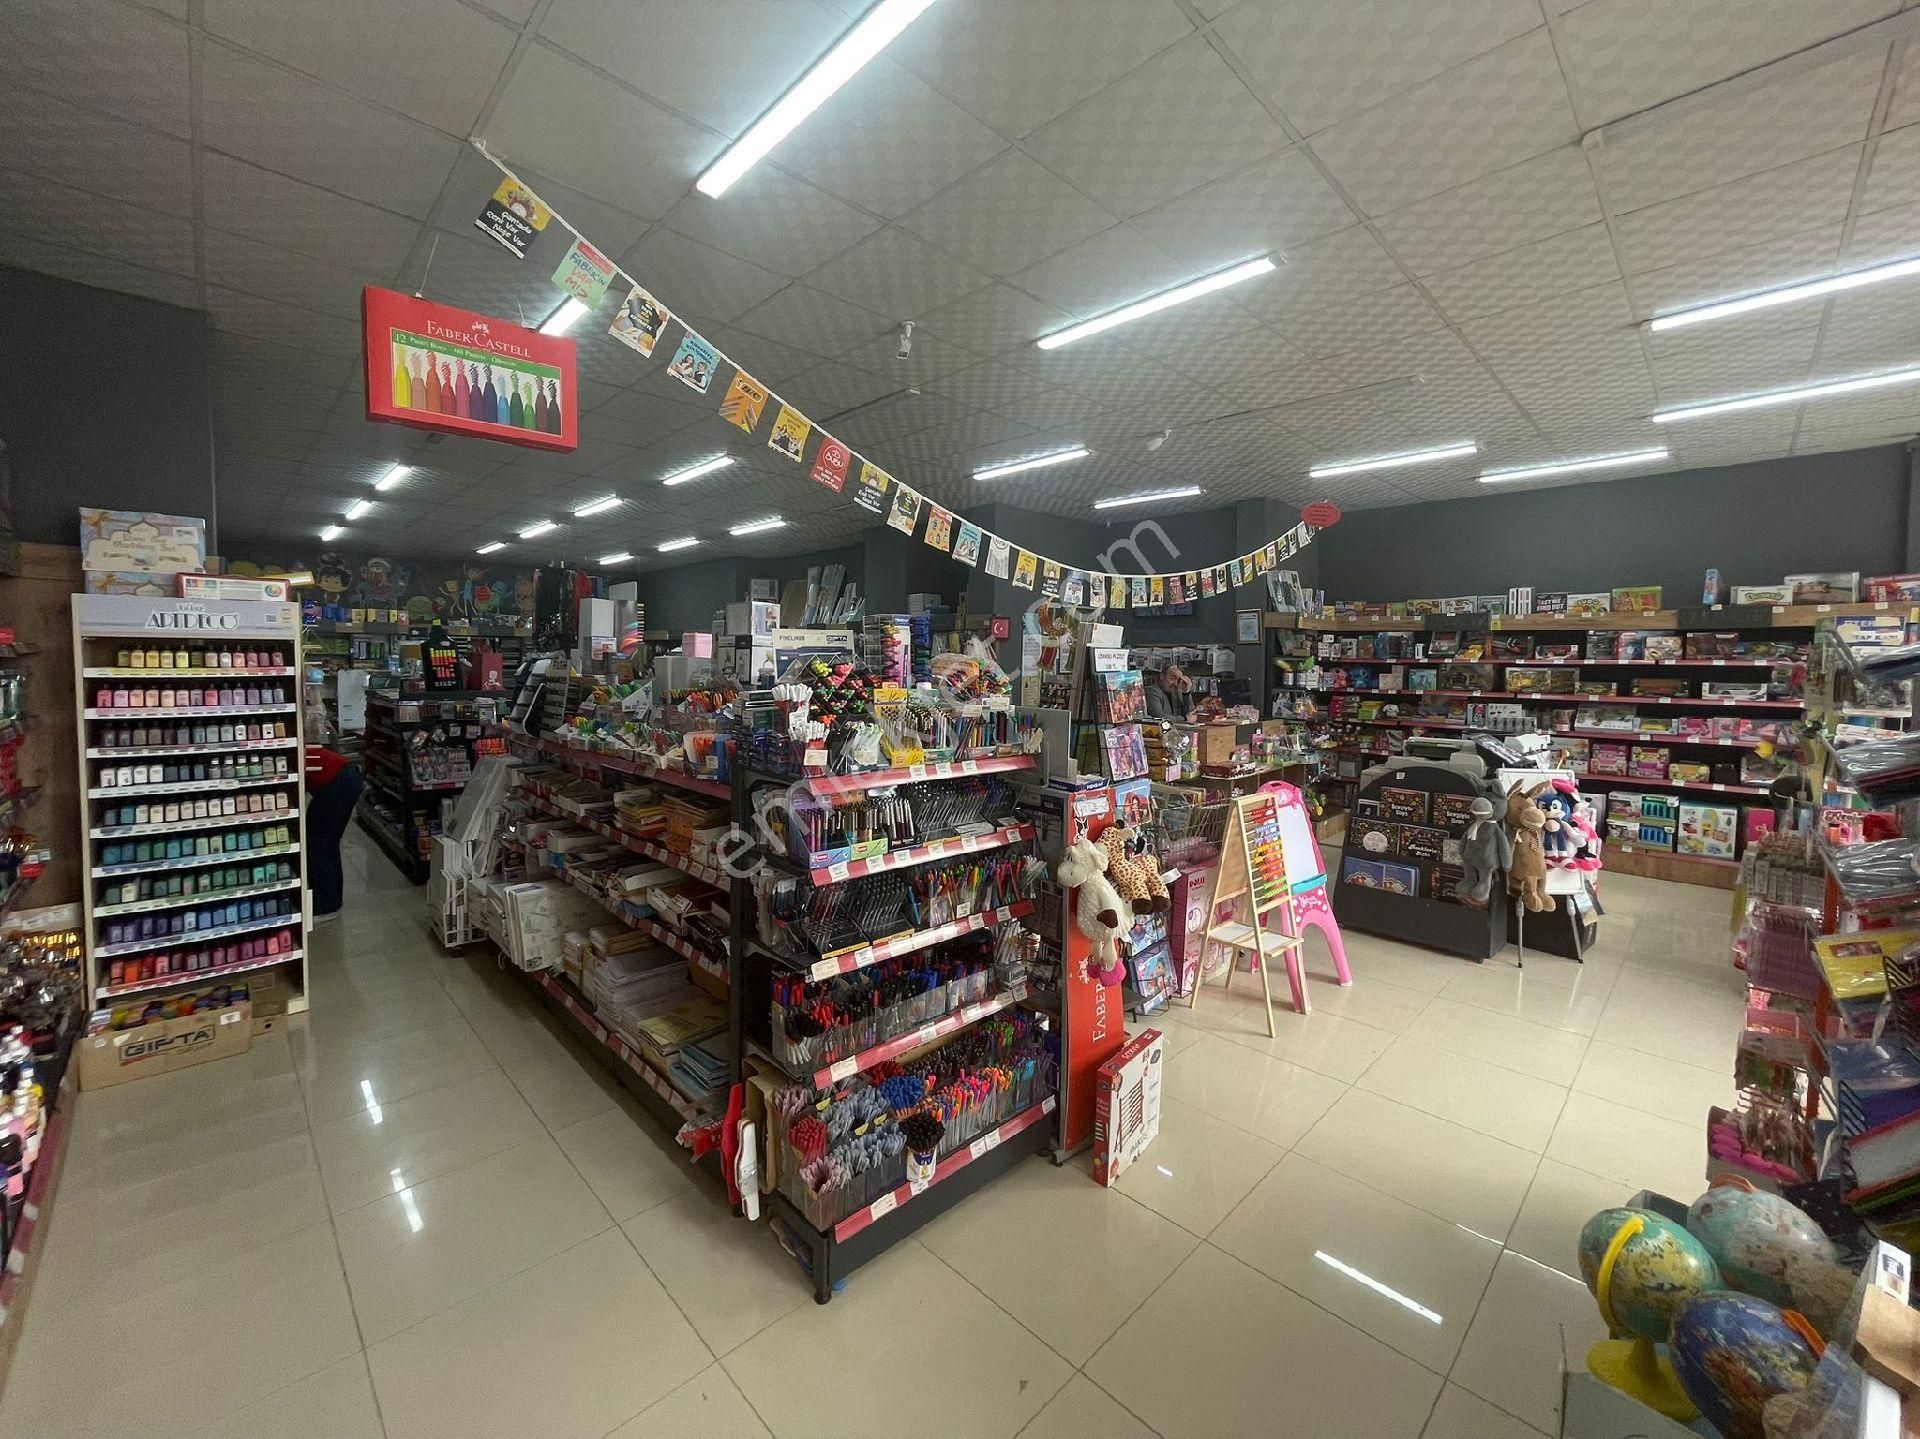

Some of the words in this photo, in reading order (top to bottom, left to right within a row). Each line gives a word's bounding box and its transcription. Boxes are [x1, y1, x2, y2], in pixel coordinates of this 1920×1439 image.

[395, 333, 407, 344] 12
[426, 319, 532, 358] FABER-CASTELL
[741, 385, 760, 400] BIC
